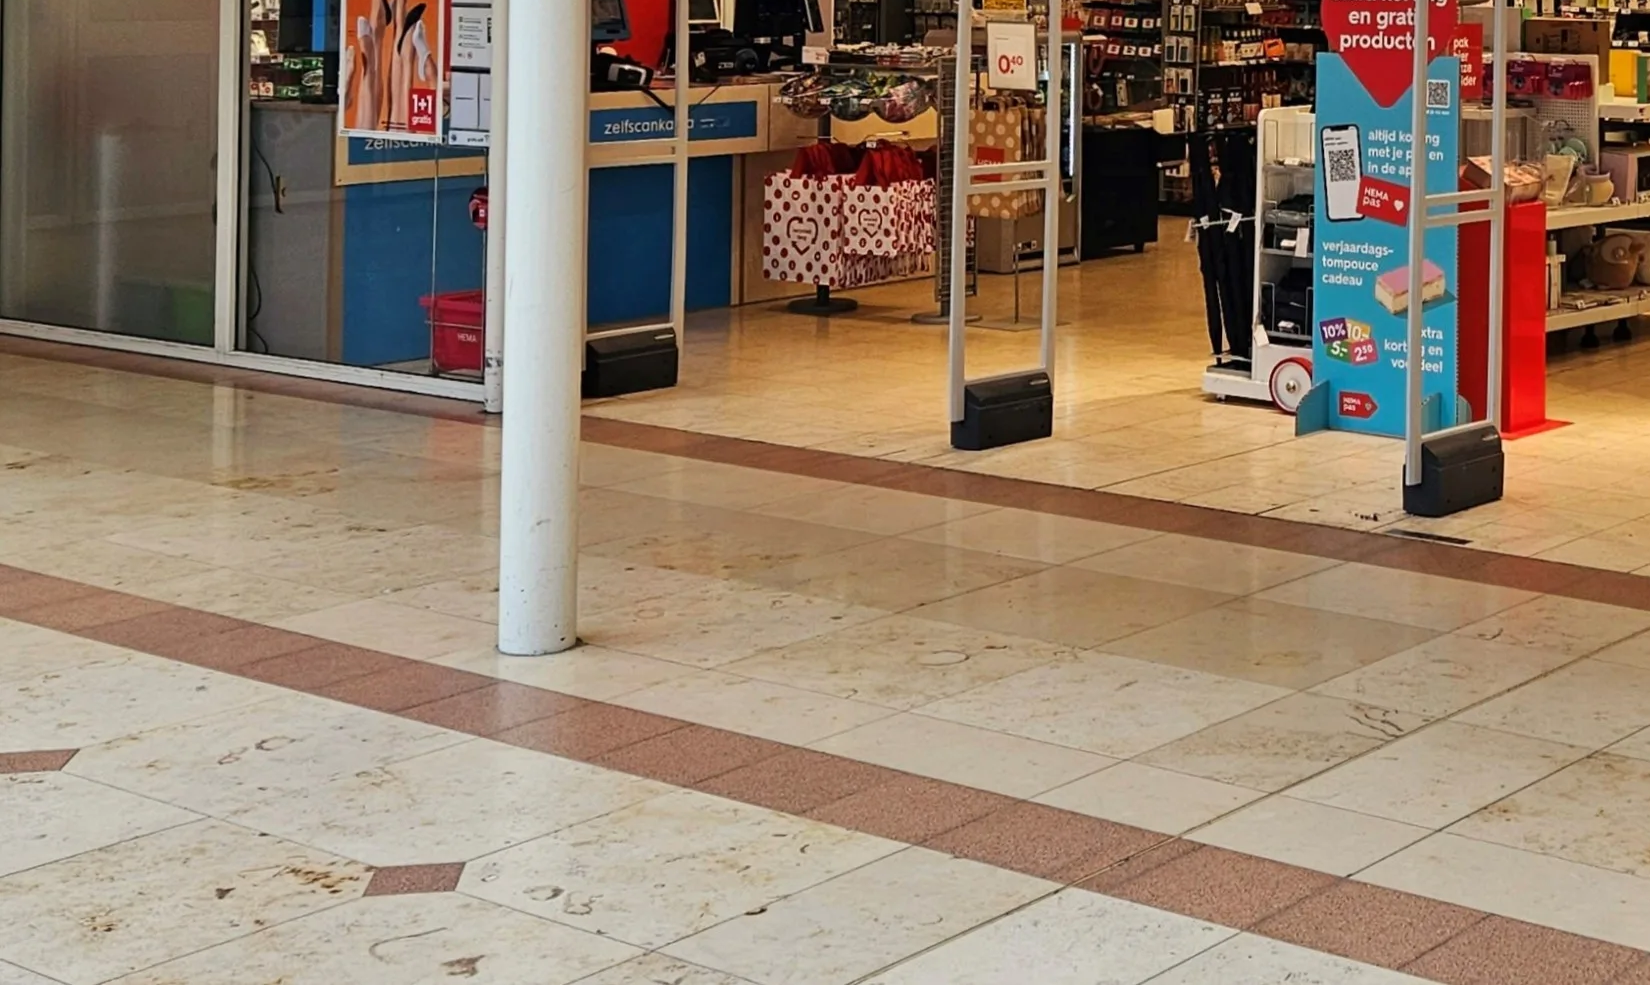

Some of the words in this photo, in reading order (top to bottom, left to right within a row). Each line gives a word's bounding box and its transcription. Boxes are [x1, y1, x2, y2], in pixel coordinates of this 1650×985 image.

[1348, 10, 1371, 25] en
[1376, 8, 1417, 28] grat
[1339, 31, 1436, 52] productn
[1453, 36, 1469, 49] pak
[411, 93, 433, 115] 1+1
[410, 115, 433, 126] gratis
[603, 118, 694, 135] zelfscankaa
[1367, 130, 1396, 145] altijd
[1398, 131, 1440, 147] kong
[1367, 147, 1391, 159] met
[1391, 149, 1403, 161] je
[1428, 150, 1444, 161] en
[1367, 162, 1379, 174] in
[1381, 162, 1397, 175] de
[1397, 166, 1412, 178] ap
[1363, 186, 1389, 201] HEMA
[1362, 197, 1381, 208] pas
[1322, 240, 1394, 257] verjaardags-
[1321, 256, 1379, 272] tompouce
[1322, 272, 1363, 287] cadeau
[457, 333, 477, 343] HEMA
[1322, 322, 1346, 340] 10%
[1420, 326, 1444, 340] xtra
[1330, 340, 1348, 357] 5.-
[1428, 345, 1444, 357] en
[1391, 357, 1444, 374] vodeel
